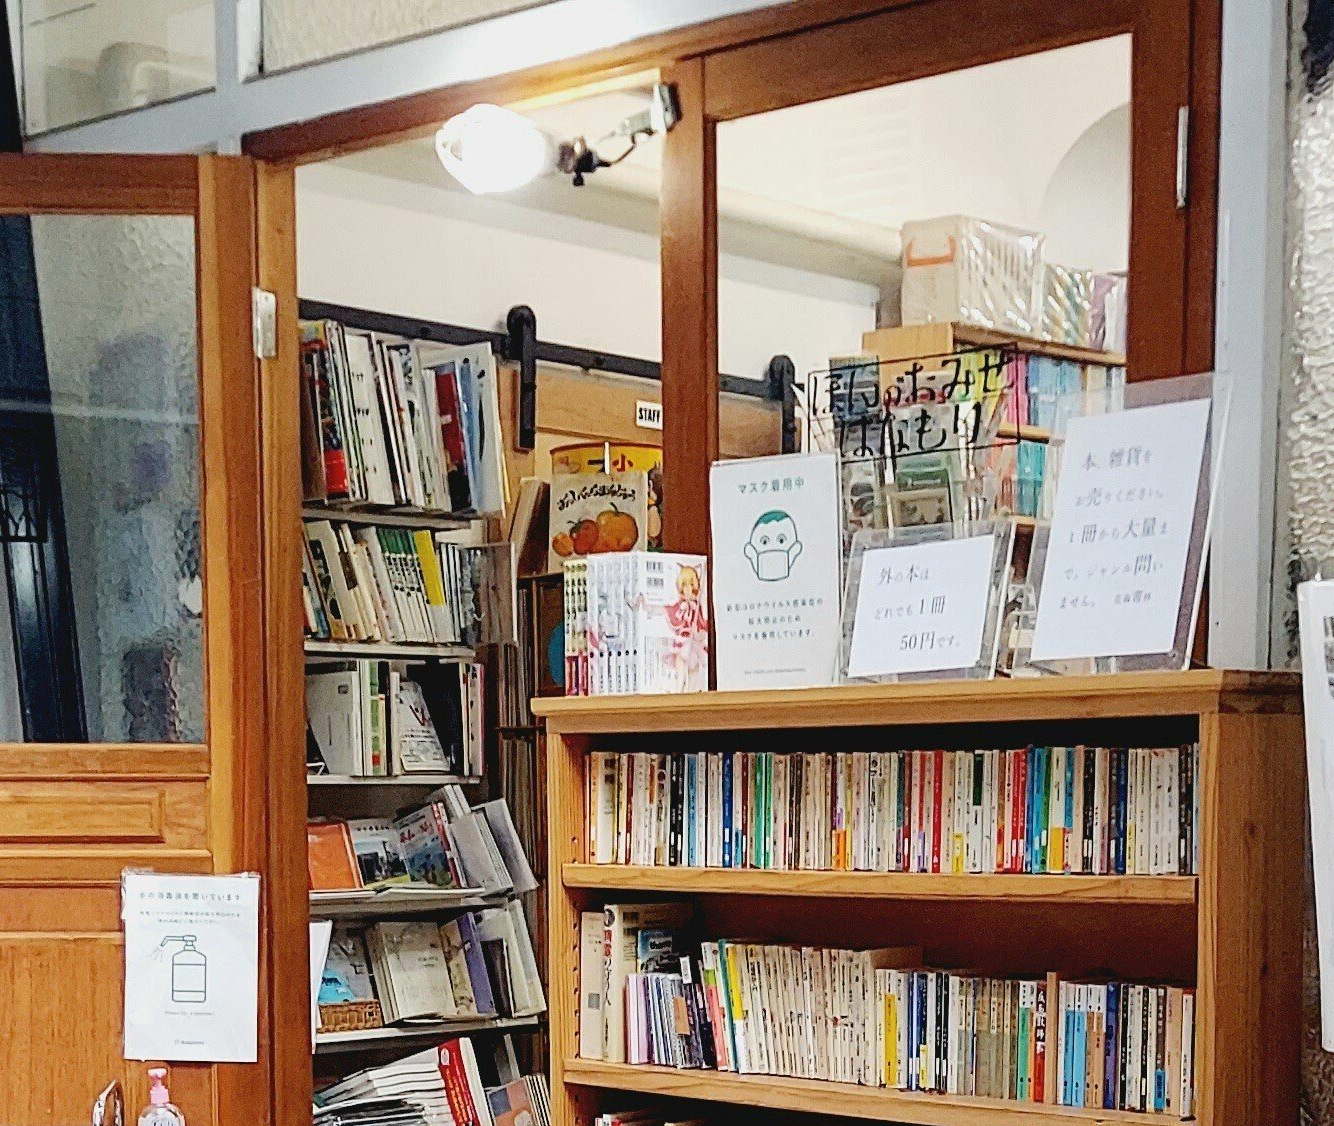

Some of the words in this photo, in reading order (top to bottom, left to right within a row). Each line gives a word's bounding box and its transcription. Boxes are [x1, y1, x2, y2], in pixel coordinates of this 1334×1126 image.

[639, 407, 660, 423] STAFF
[738, 477, 805, 494] マスク着用中
[878, 564, 929, 585] 外の本は
